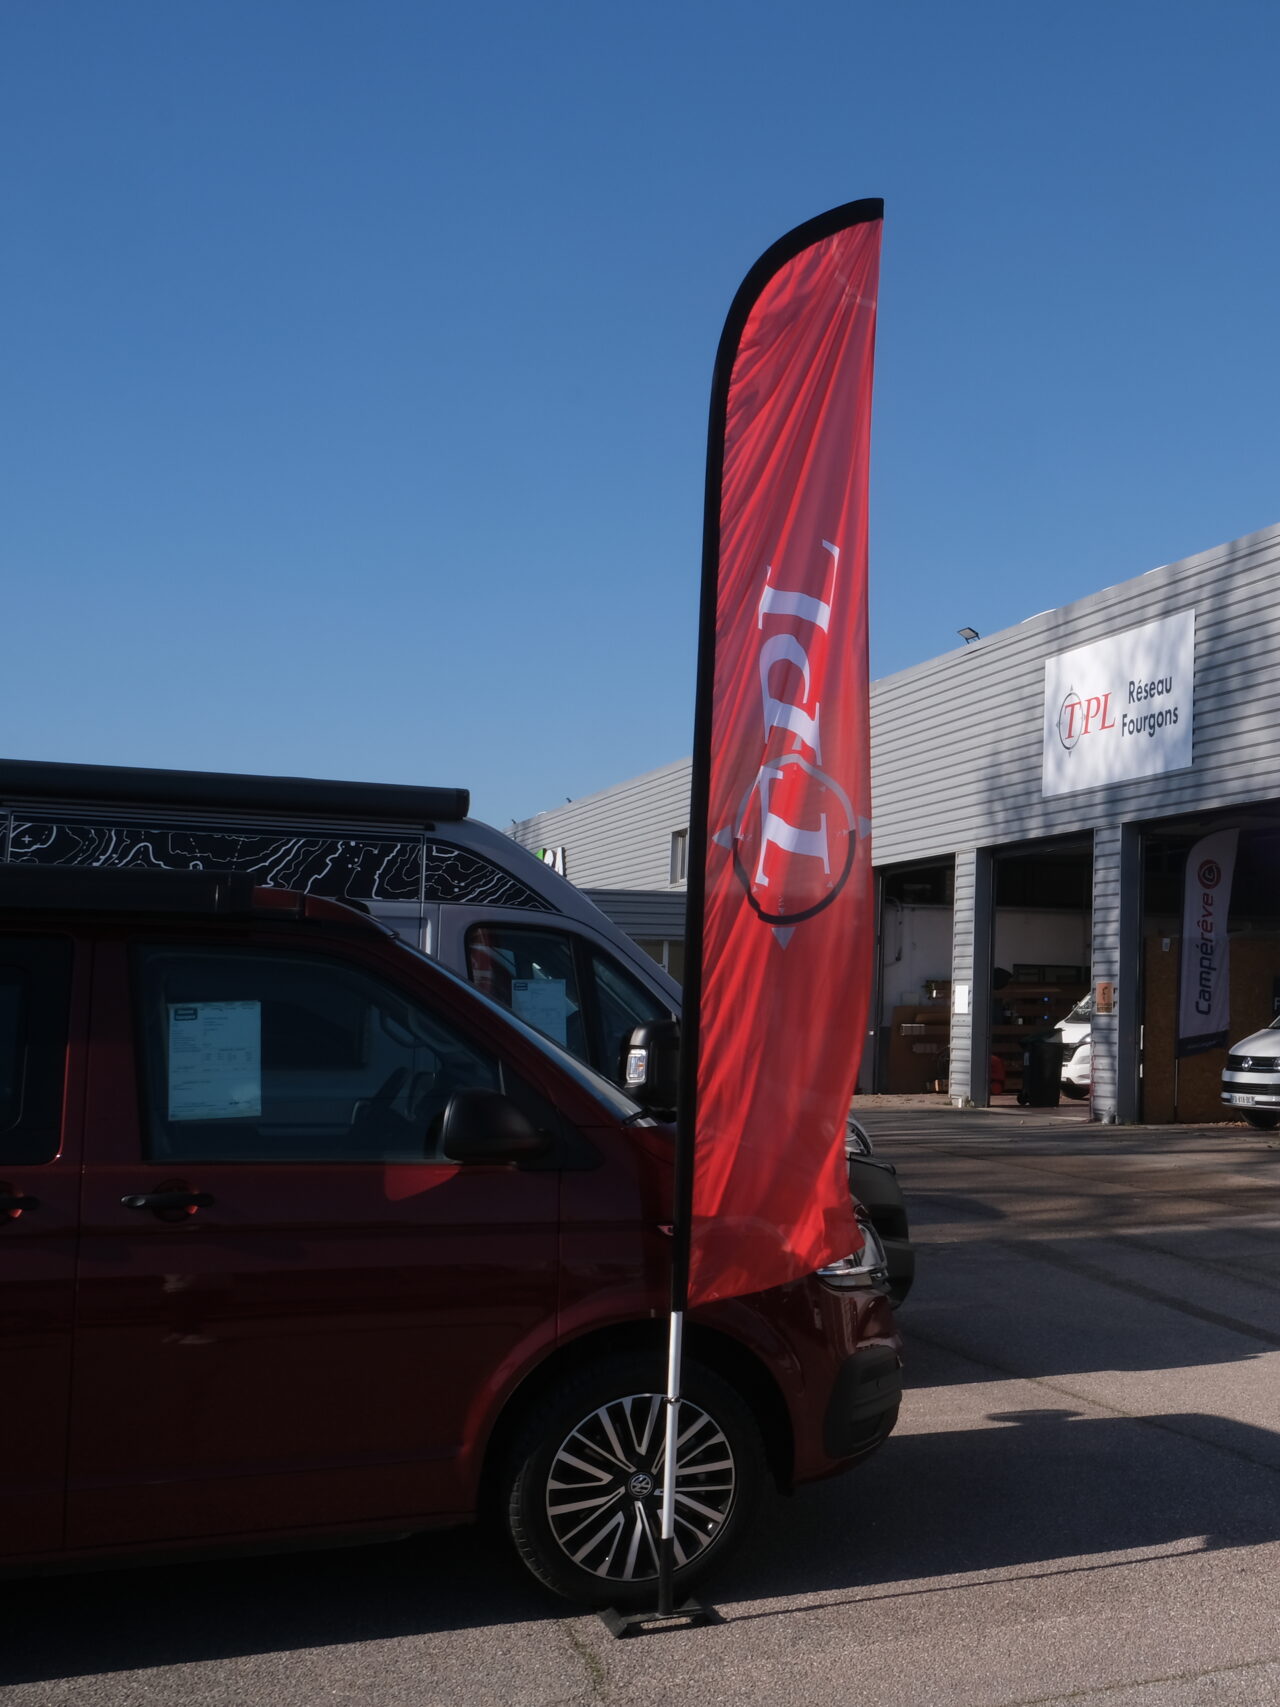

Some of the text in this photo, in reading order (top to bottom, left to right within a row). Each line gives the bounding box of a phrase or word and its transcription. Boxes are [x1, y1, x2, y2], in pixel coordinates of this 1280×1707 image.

[755, 539, 840, 887] TPL
[1128, 676, 1173, 705] Réseau
[1064, 691, 1116, 740] TPL
[1121, 706, 1179, 738] Fourgons
[1195, 893, 1217, 1016] Campérêve
